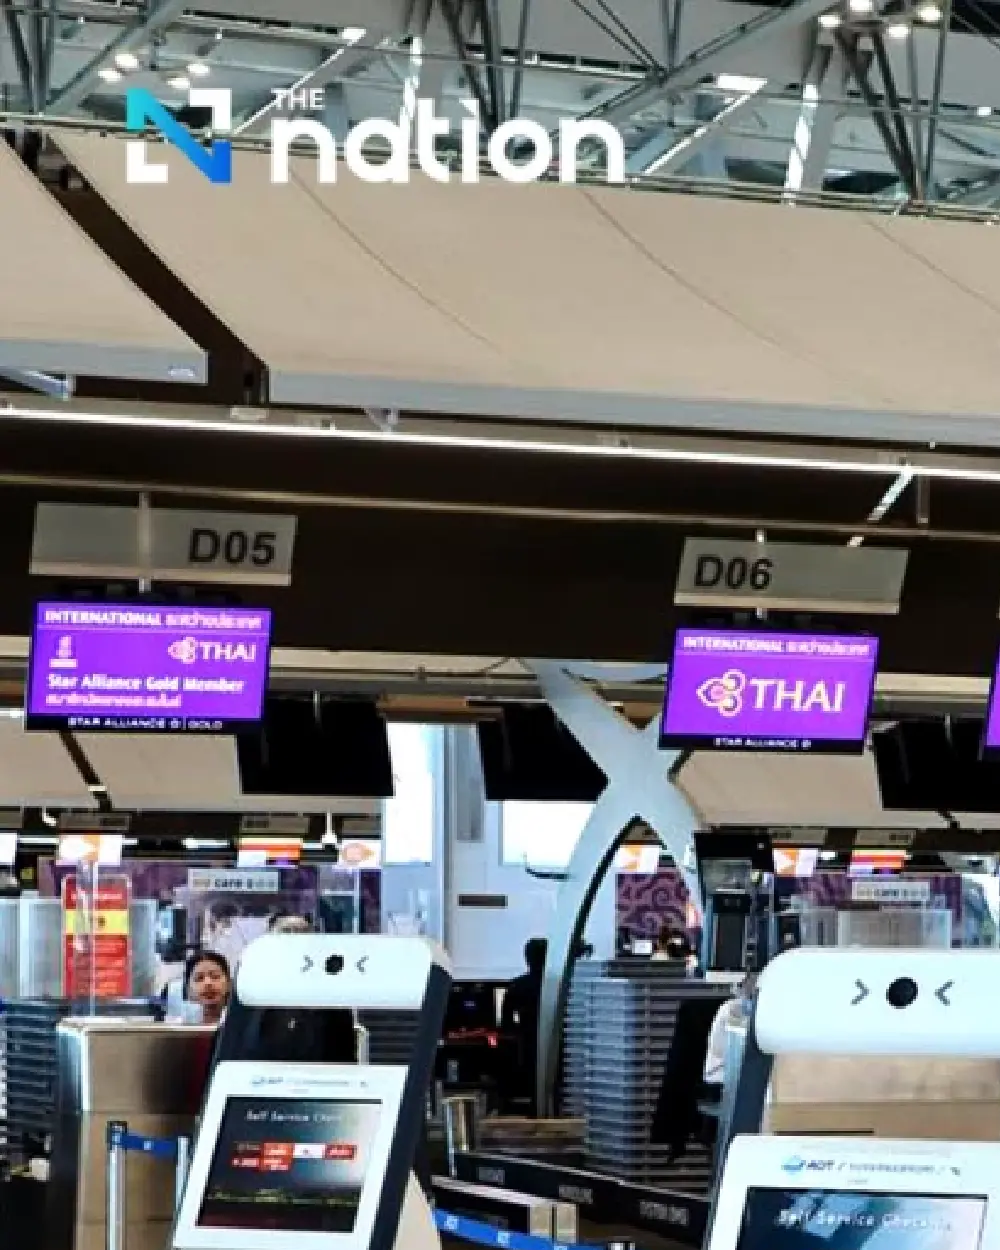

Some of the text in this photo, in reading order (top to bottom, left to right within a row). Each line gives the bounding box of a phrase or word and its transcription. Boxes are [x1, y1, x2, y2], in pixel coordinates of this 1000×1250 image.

[188, 527, 276, 566] D05
[693, 555, 773, 591] D06
[45, 609, 163, 627] INTERNATIONAL
[200, 640, 257, 664] THAI
[683, 636, 783, 654] INTERNATIONAL
[48, 673, 244, 694] Star Alliance Gold Member
[749, 678, 848, 713] THAI
[67, 716, 102, 727] STAR
[104, 718, 167, 729] ALLIANCE
[713, 737, 799, 749] STAR ALLIANCE
[817, 1210, 876, 1228] Service
